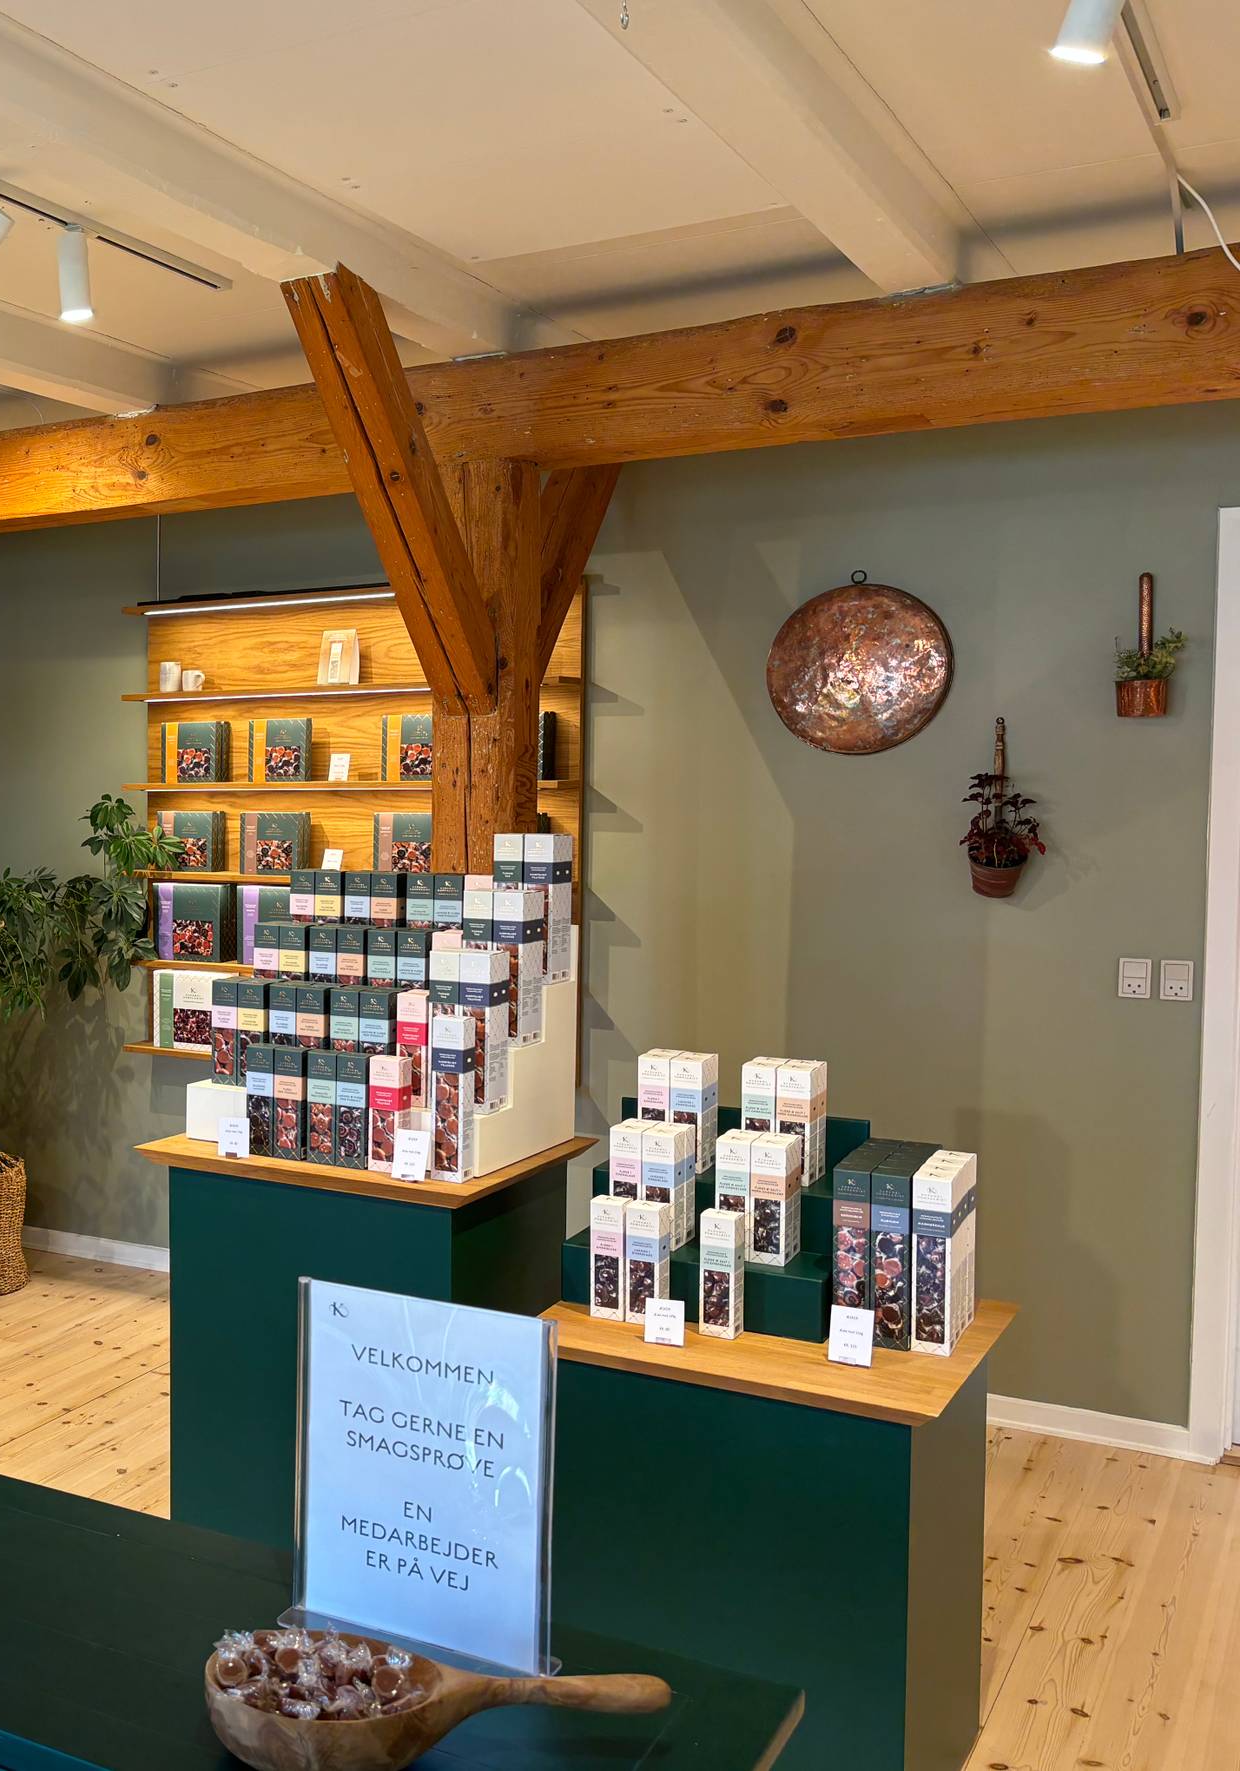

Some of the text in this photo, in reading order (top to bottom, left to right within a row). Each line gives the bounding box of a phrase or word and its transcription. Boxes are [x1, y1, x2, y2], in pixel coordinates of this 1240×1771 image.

[351, 1343, 494, 1386] VELKOMMEN
[339, 1398, 505, 1451] TAG GERNE EN
[346, 1430, 495, 1479] SMAGSPRØVE
[403, 1501, 432, 1523] EN
[341, 1515, 499, 1569] MEDARBEJDER
[365, 1550, 470, 1592] ER PÅ VEJ
